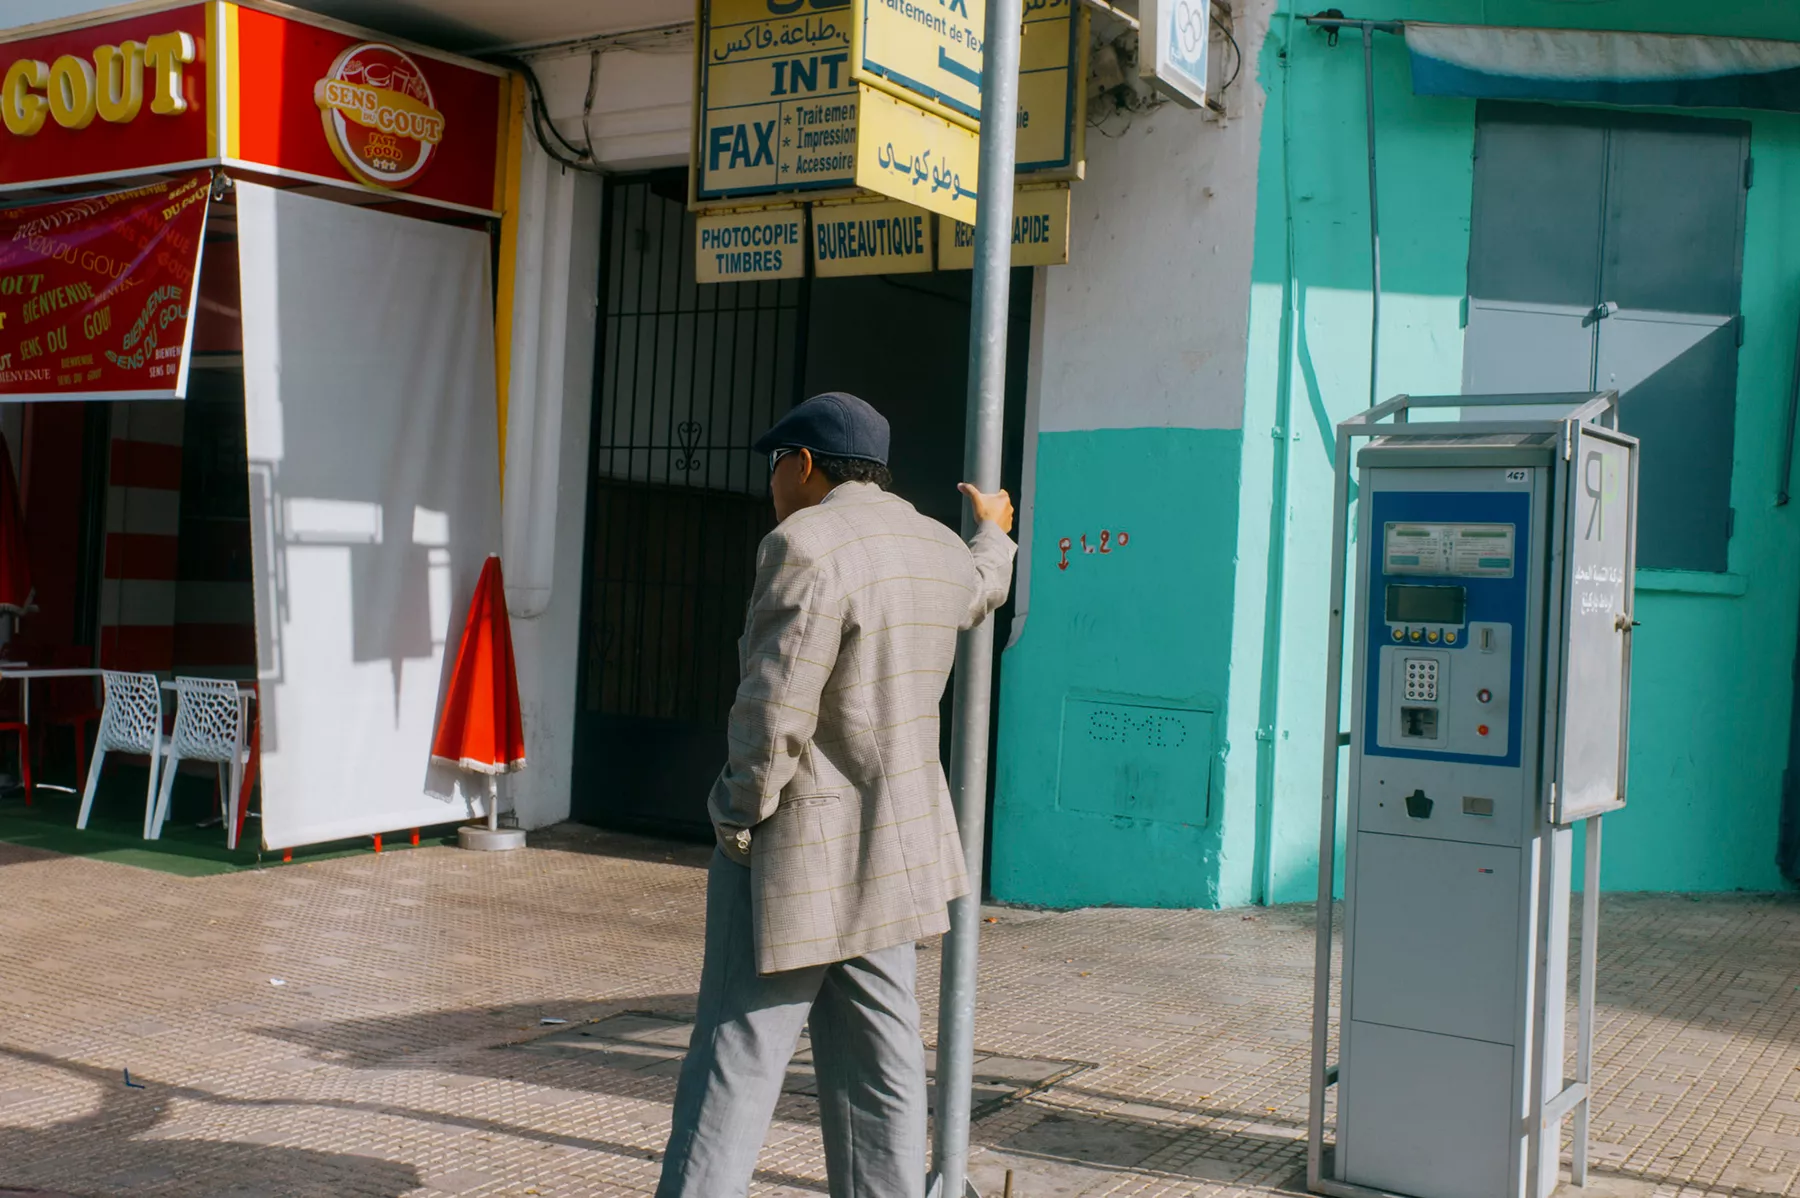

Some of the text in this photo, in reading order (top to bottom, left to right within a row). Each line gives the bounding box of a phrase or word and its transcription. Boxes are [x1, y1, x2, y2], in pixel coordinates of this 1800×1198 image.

[880, 0, 946, 36] aitement
[949, 24, 963, 43] de
[2, 30, 196, 136] GOUT
[771, 53, 857, 96] INT
[326, 81, 378, 112] SENS
[369, 132, 397, 147] FAST
[377, 106, 441, 141] GOUT
[796, 125, 856, 152] Impression
[364, 144, 404, 160] FOOD
[709, 120, 776, 171] FAX
[796, 152, 855, 174] Accessoire
[878, 142, 978, 201] وطوكوبي
[162, 203, 180, 220] DU
[702, 223, 798, 249] PHOTOCOPIE
[817, 216, 923, 261] BUREAUTIQUE
[1011, 214, 1050, 245] APIDE
[716, 250, 783, 275] TIMBRES
[23, 281, 95, 324] BIENVENUE
[123, 285, 183, 350] BIENVENUE
